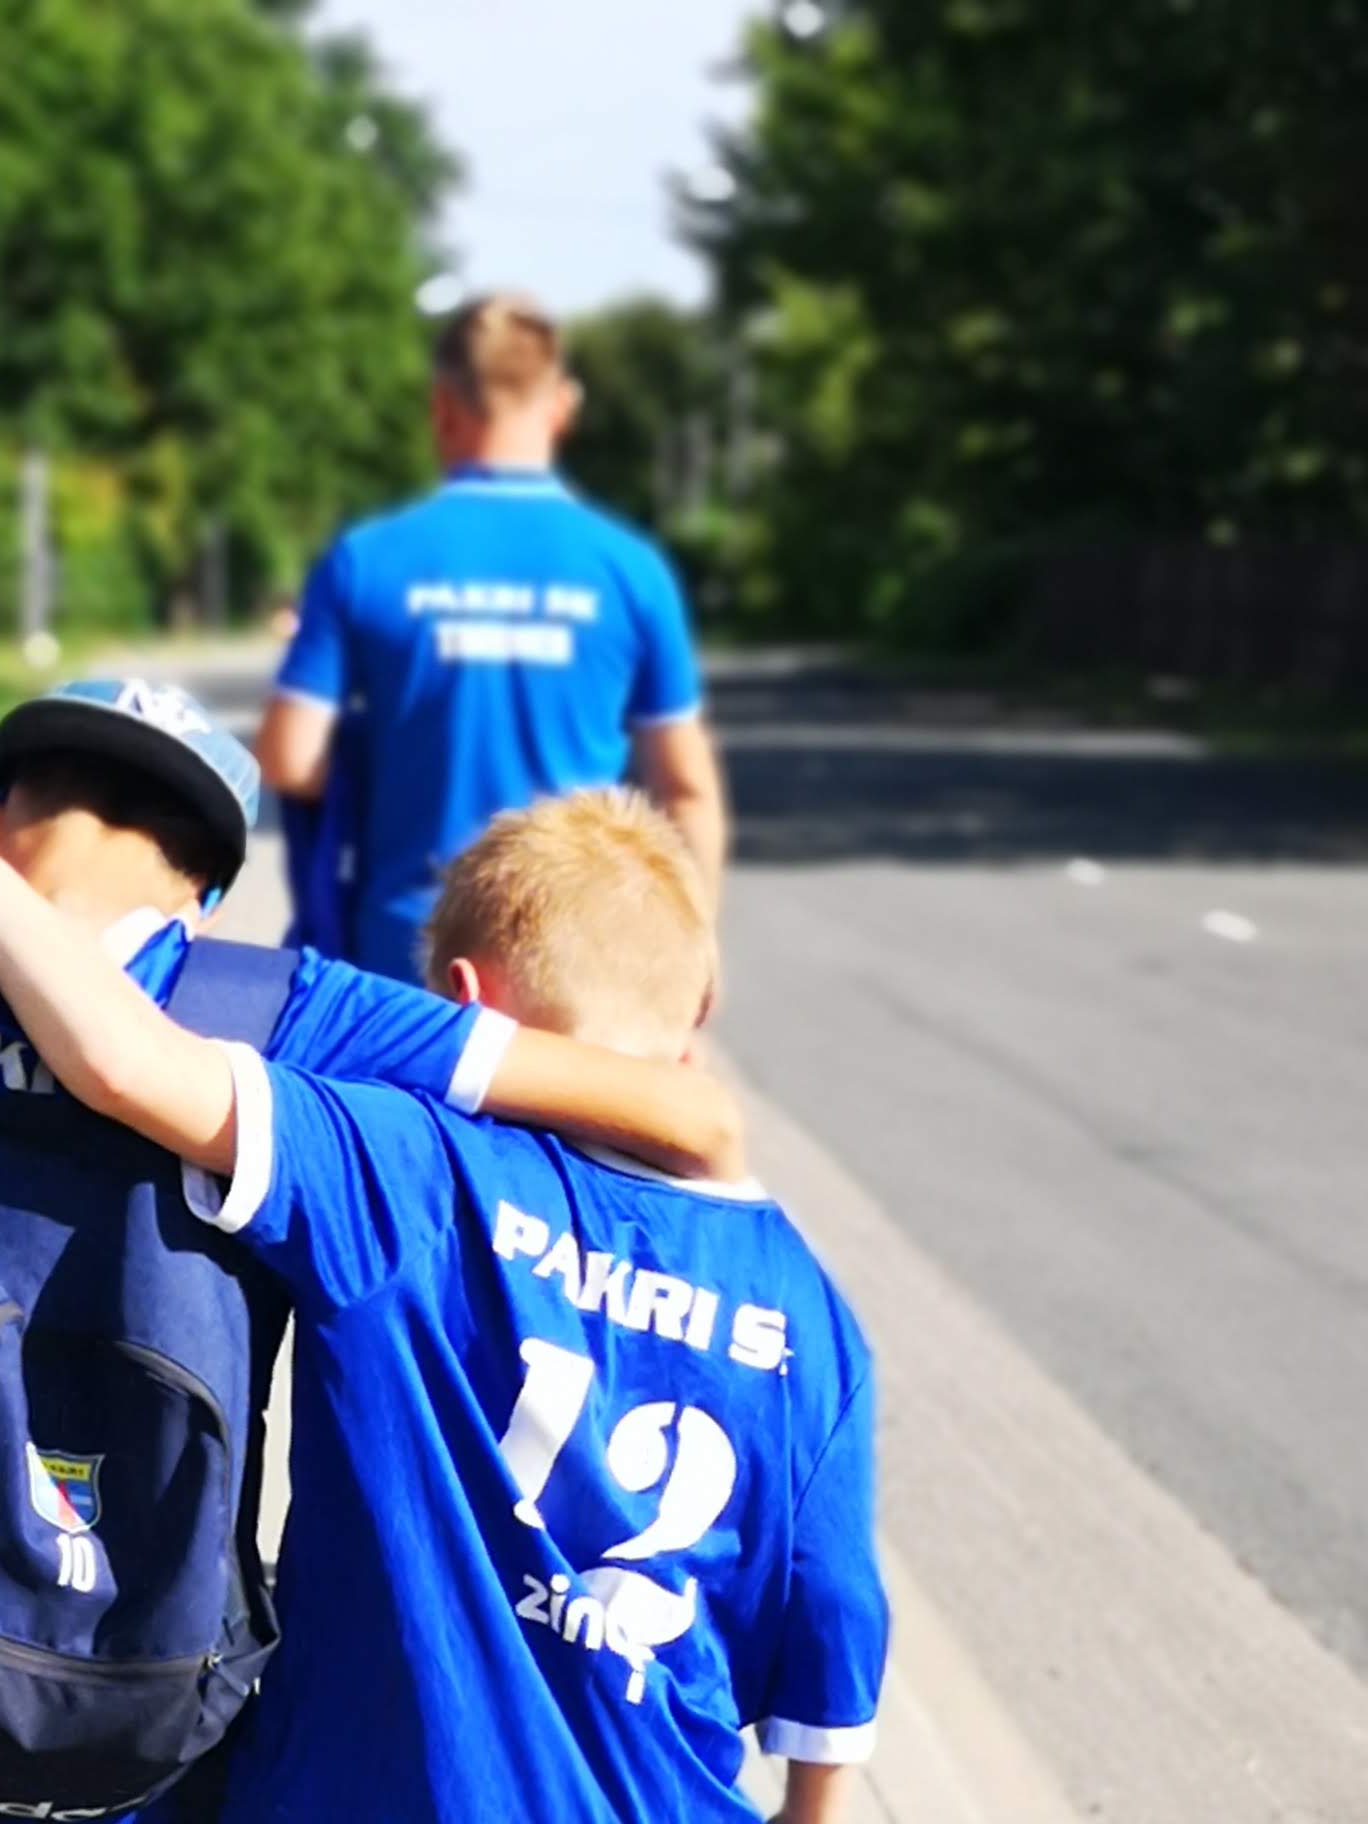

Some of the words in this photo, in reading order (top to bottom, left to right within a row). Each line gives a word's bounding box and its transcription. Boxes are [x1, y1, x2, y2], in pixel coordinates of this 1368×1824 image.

[493, 1199, 719, 1350] PAKRI
[727, 1303, 795, 1376] S
[56, 1532, 98, 1593] 10
